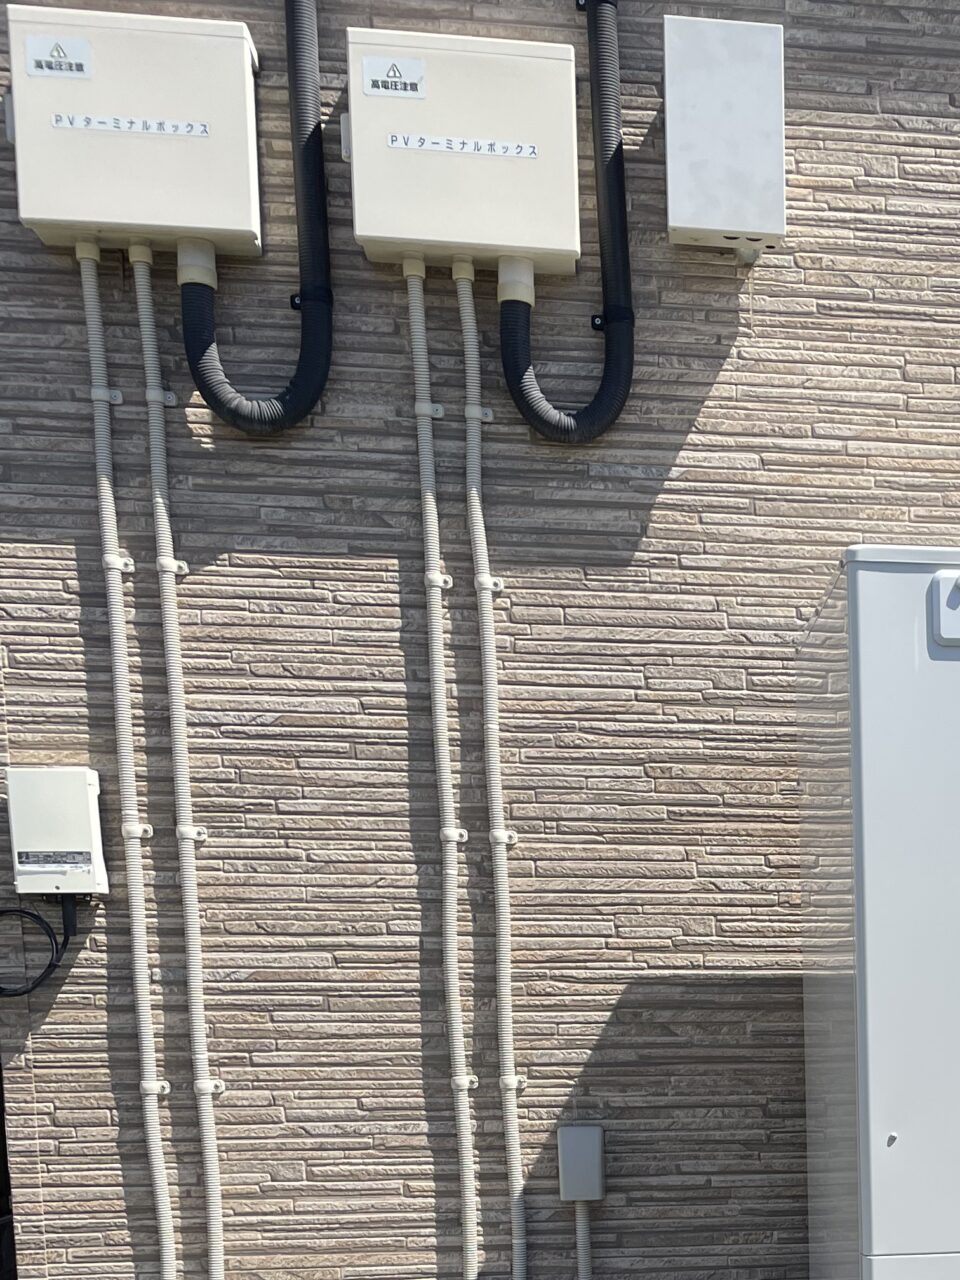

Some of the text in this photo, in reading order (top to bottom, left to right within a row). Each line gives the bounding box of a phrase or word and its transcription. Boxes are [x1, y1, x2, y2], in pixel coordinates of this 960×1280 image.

[370, 79, 419, 93] 高電圧注意
